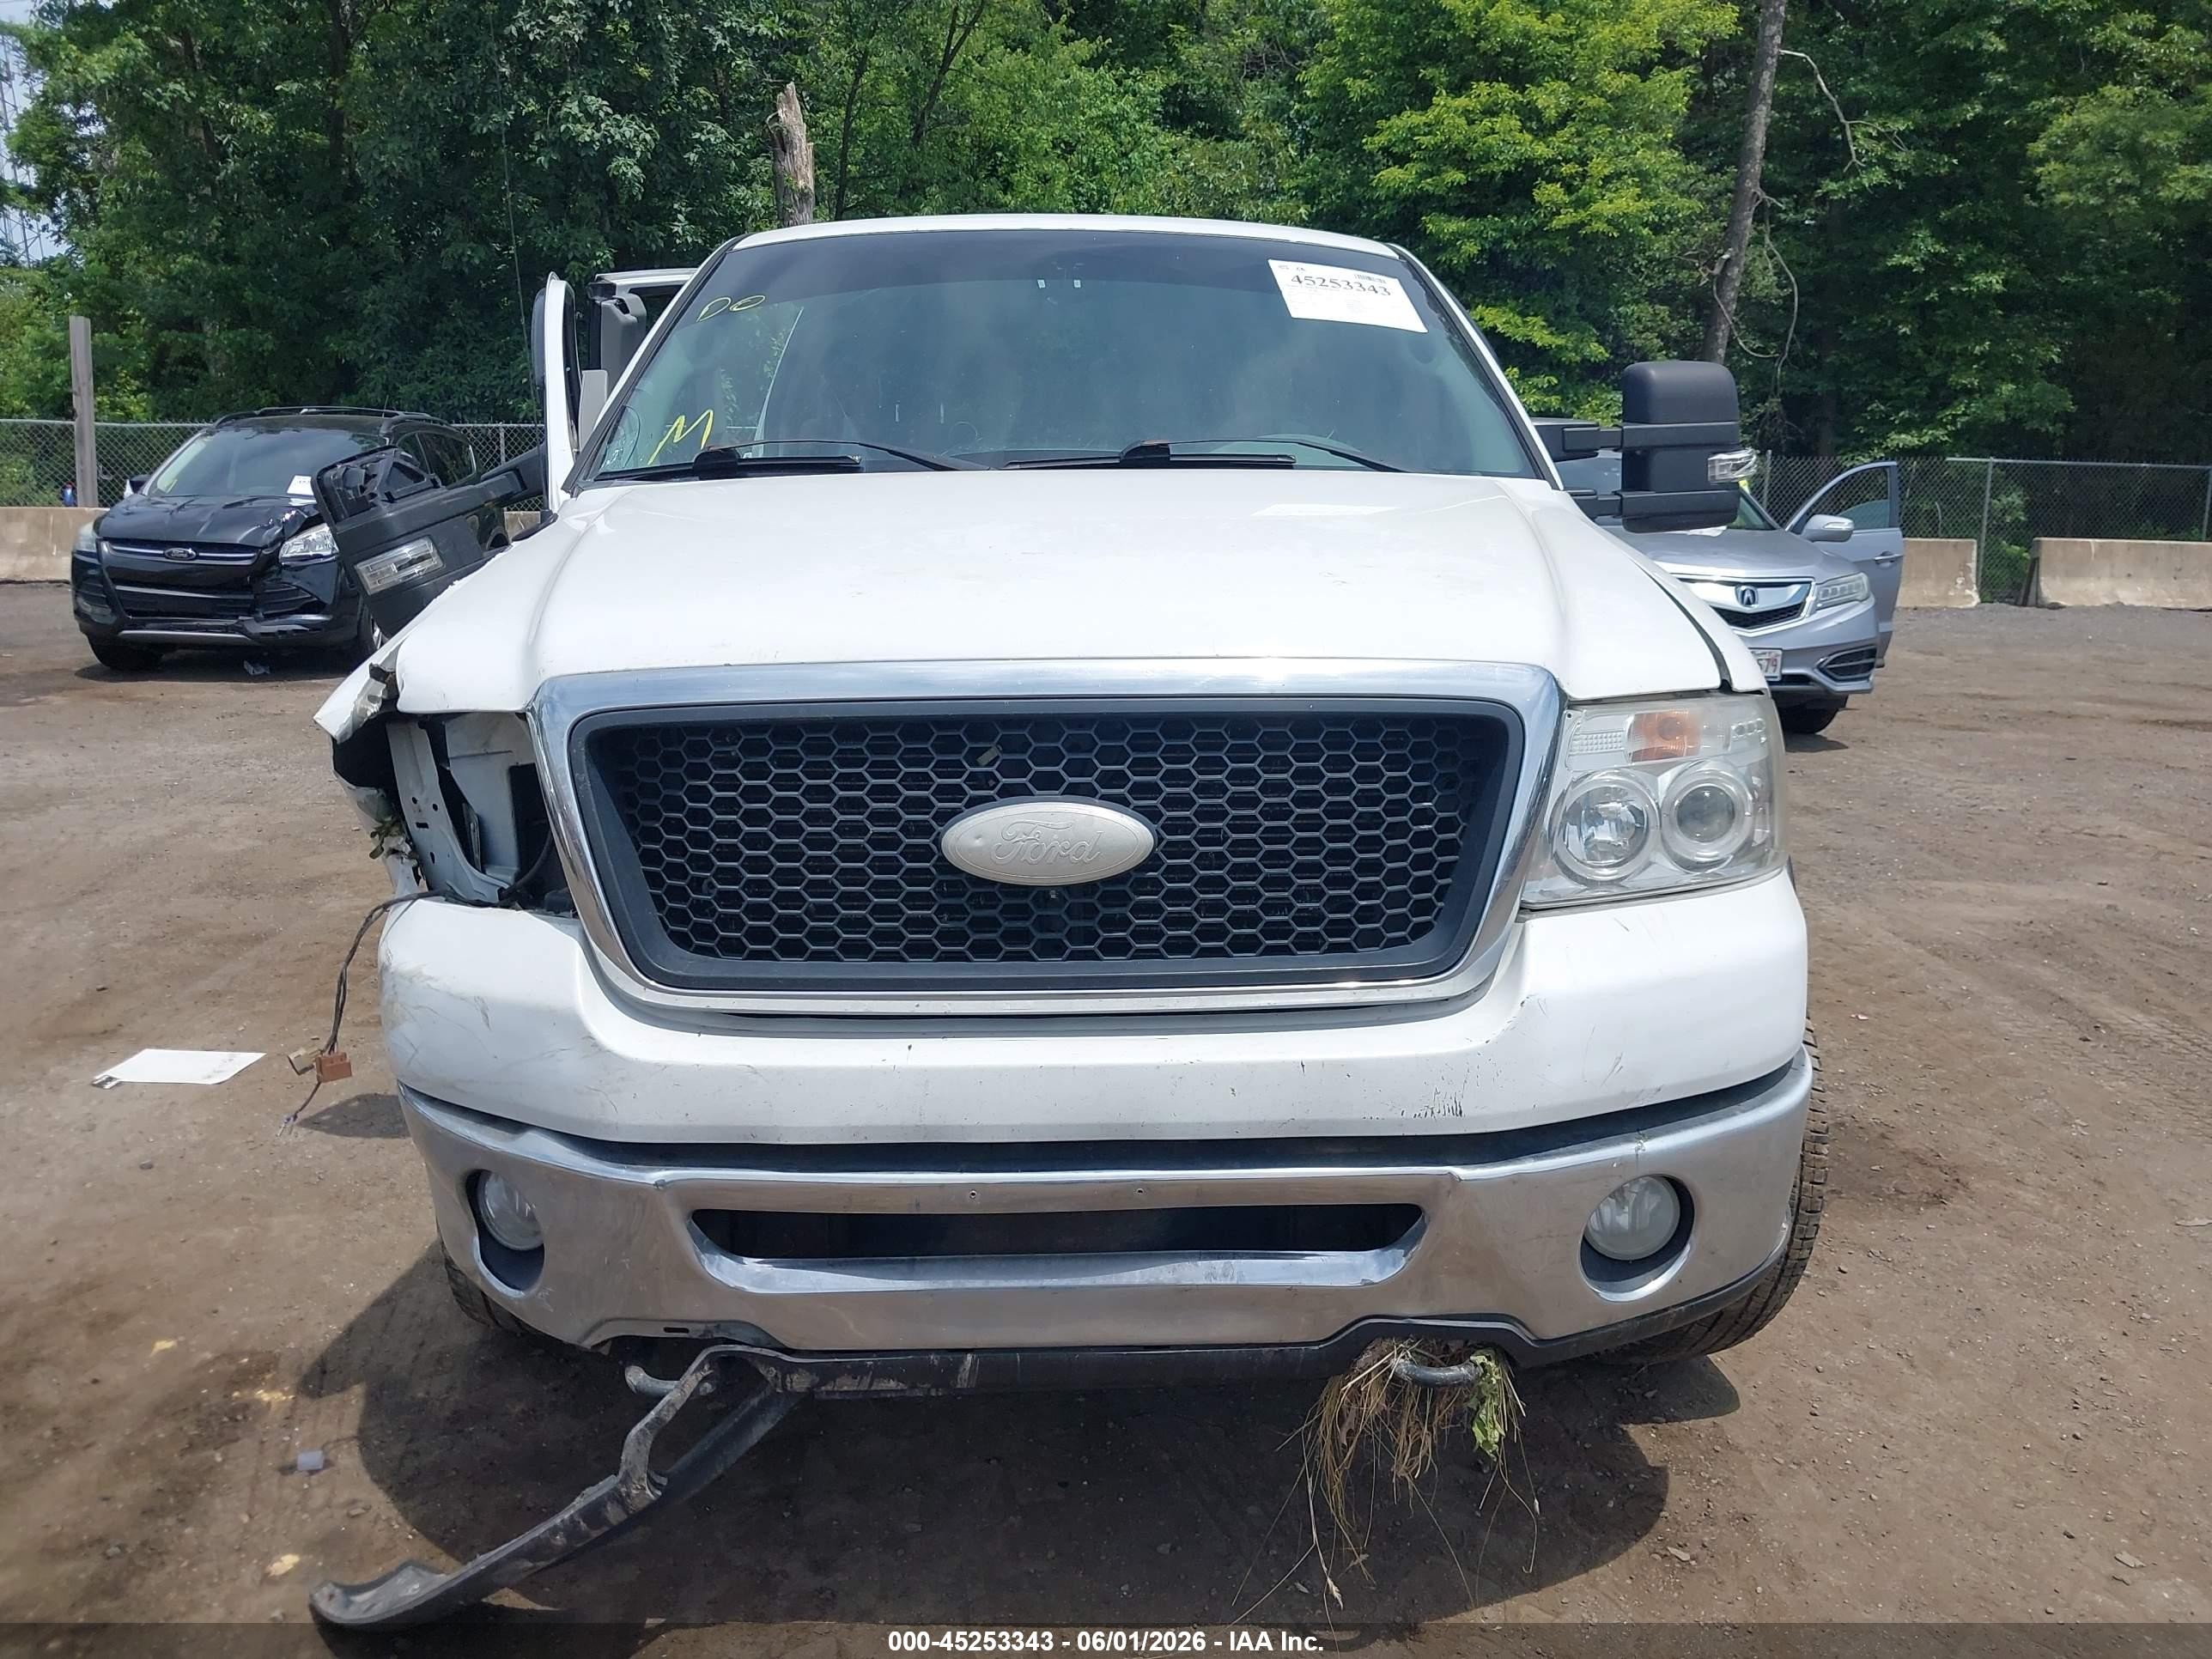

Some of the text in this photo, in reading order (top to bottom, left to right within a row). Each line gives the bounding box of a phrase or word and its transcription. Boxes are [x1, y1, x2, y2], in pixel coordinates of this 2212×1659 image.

[1291, 275, 1392, 297] 45253343
[647, 409, 714, 465] M
[991, 819, 1103, 866] Ford
